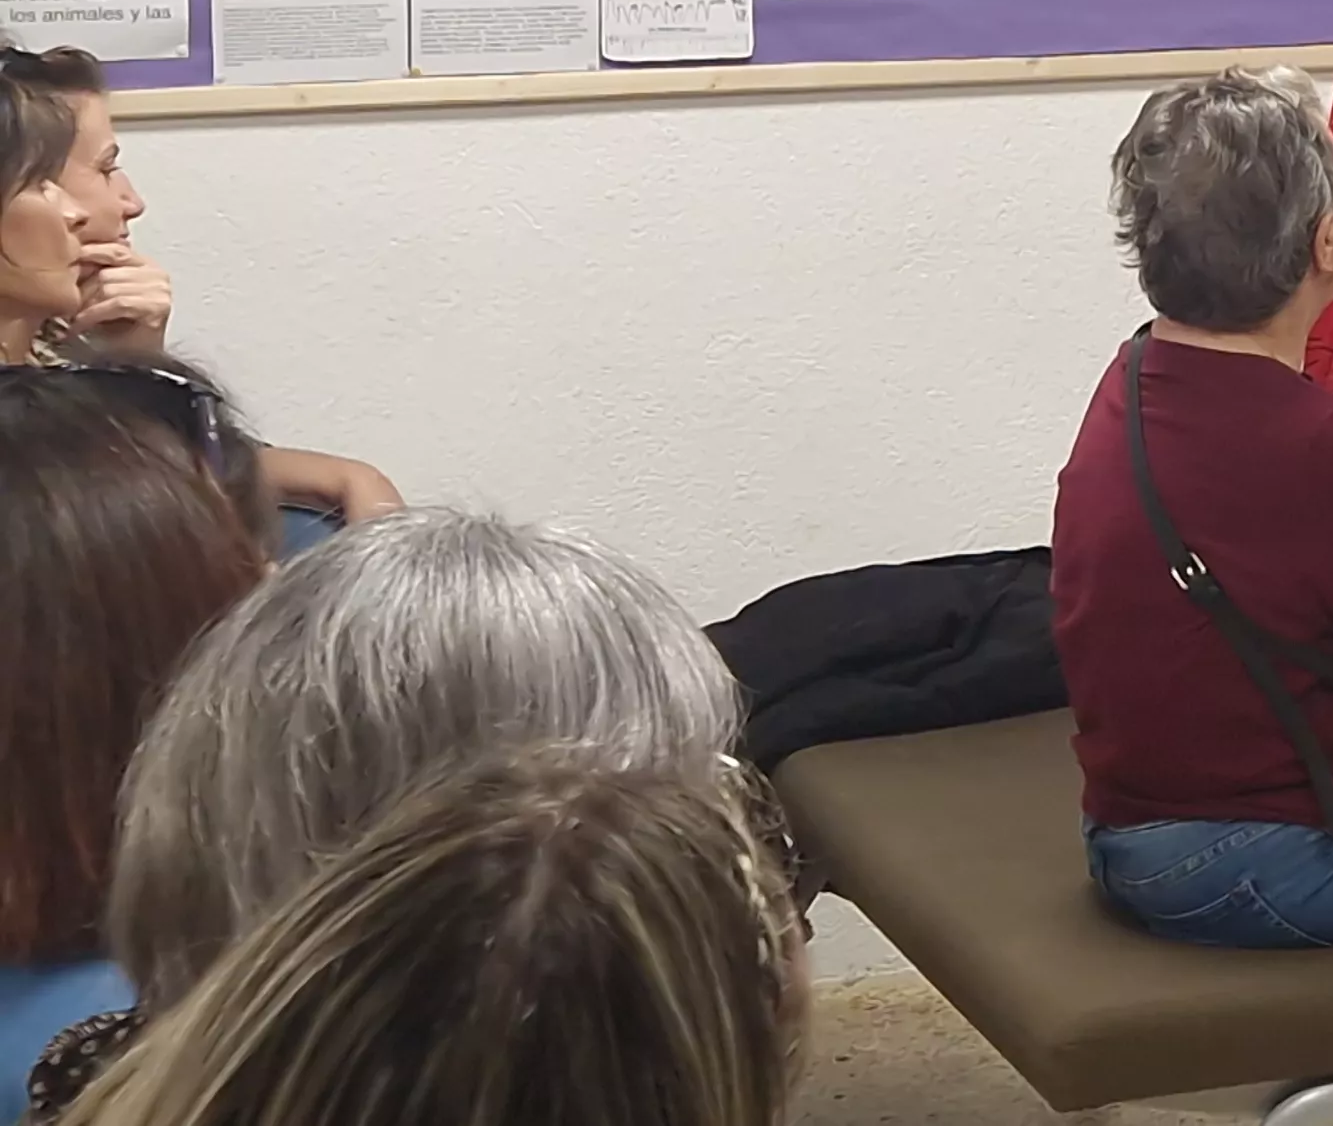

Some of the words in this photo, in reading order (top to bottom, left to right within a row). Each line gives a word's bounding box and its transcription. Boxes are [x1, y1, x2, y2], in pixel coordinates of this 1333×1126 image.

[9, 8, 37, 23] los
[42, 6, 125, 22] animales
[130, 9, 141, 24] y
[146, 5, 173, 20] las
